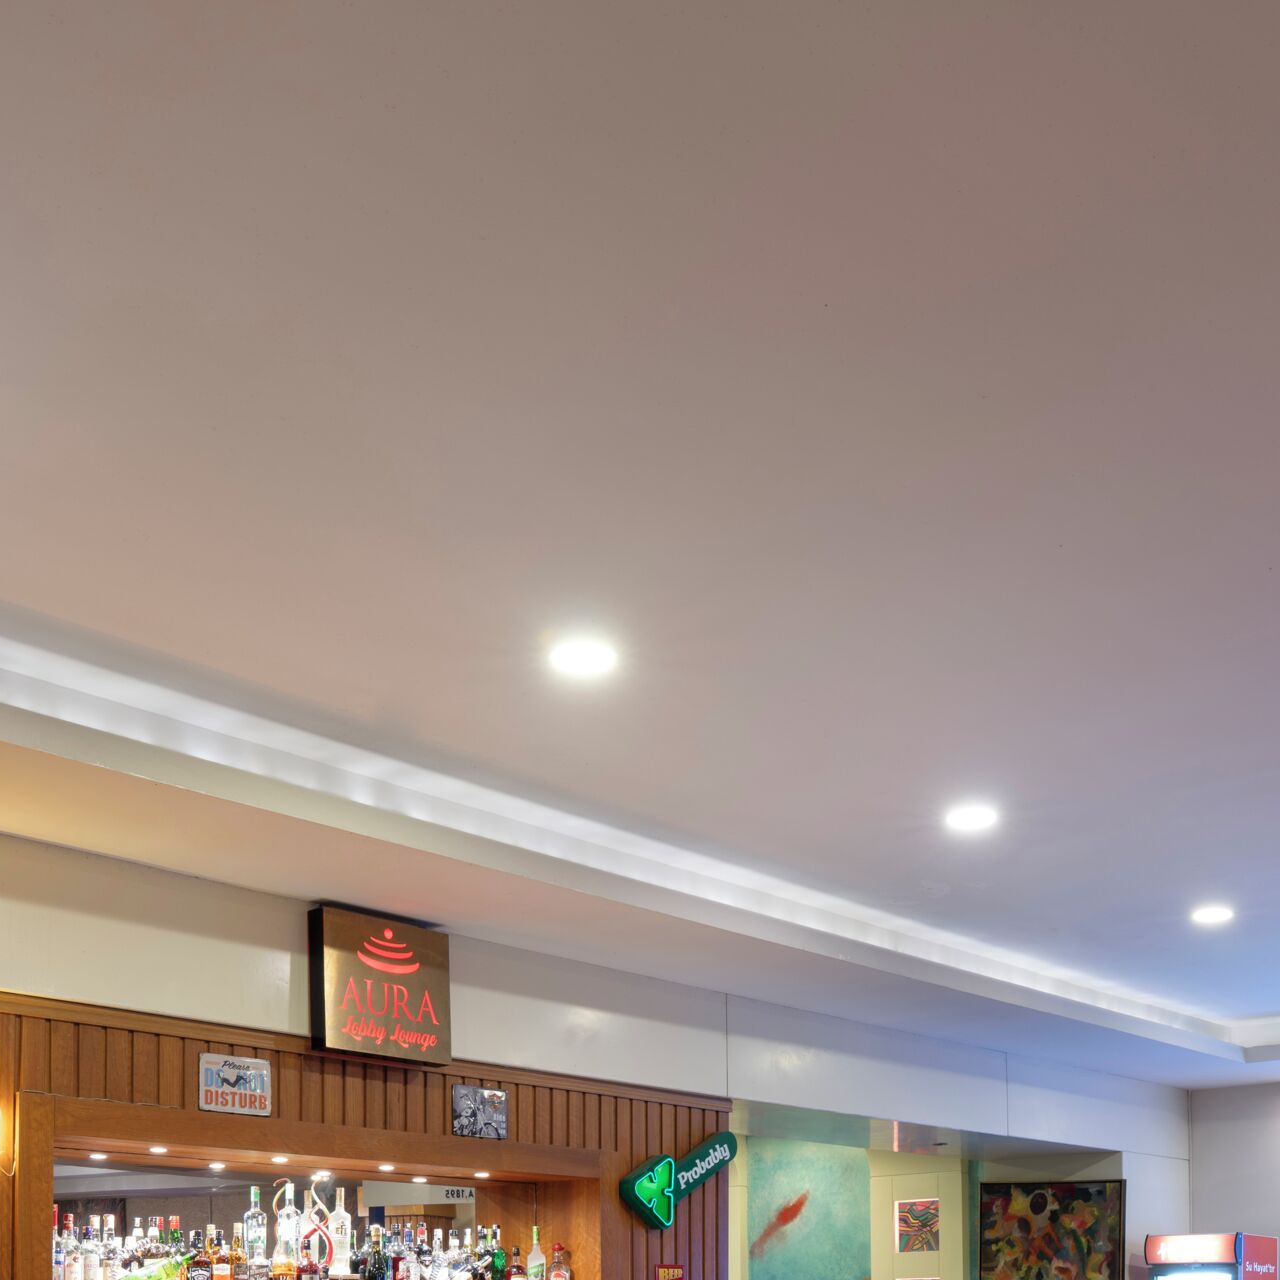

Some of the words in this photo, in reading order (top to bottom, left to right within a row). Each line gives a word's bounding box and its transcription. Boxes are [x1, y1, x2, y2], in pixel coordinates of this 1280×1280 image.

[340, 975, 440, 1025] AURA
[341, 1015, 387, 1046] Lobby
[390, 1023, 438, 1052] Lounge
[204, 1068, 224, 1088] DO
[237, 1071, 265, 1093] NOT
[222, 1060, 250, 1071] Please
[204, 1089, 267, 1110] DISTURB
[677, 1144, 731, 1189] Probably
